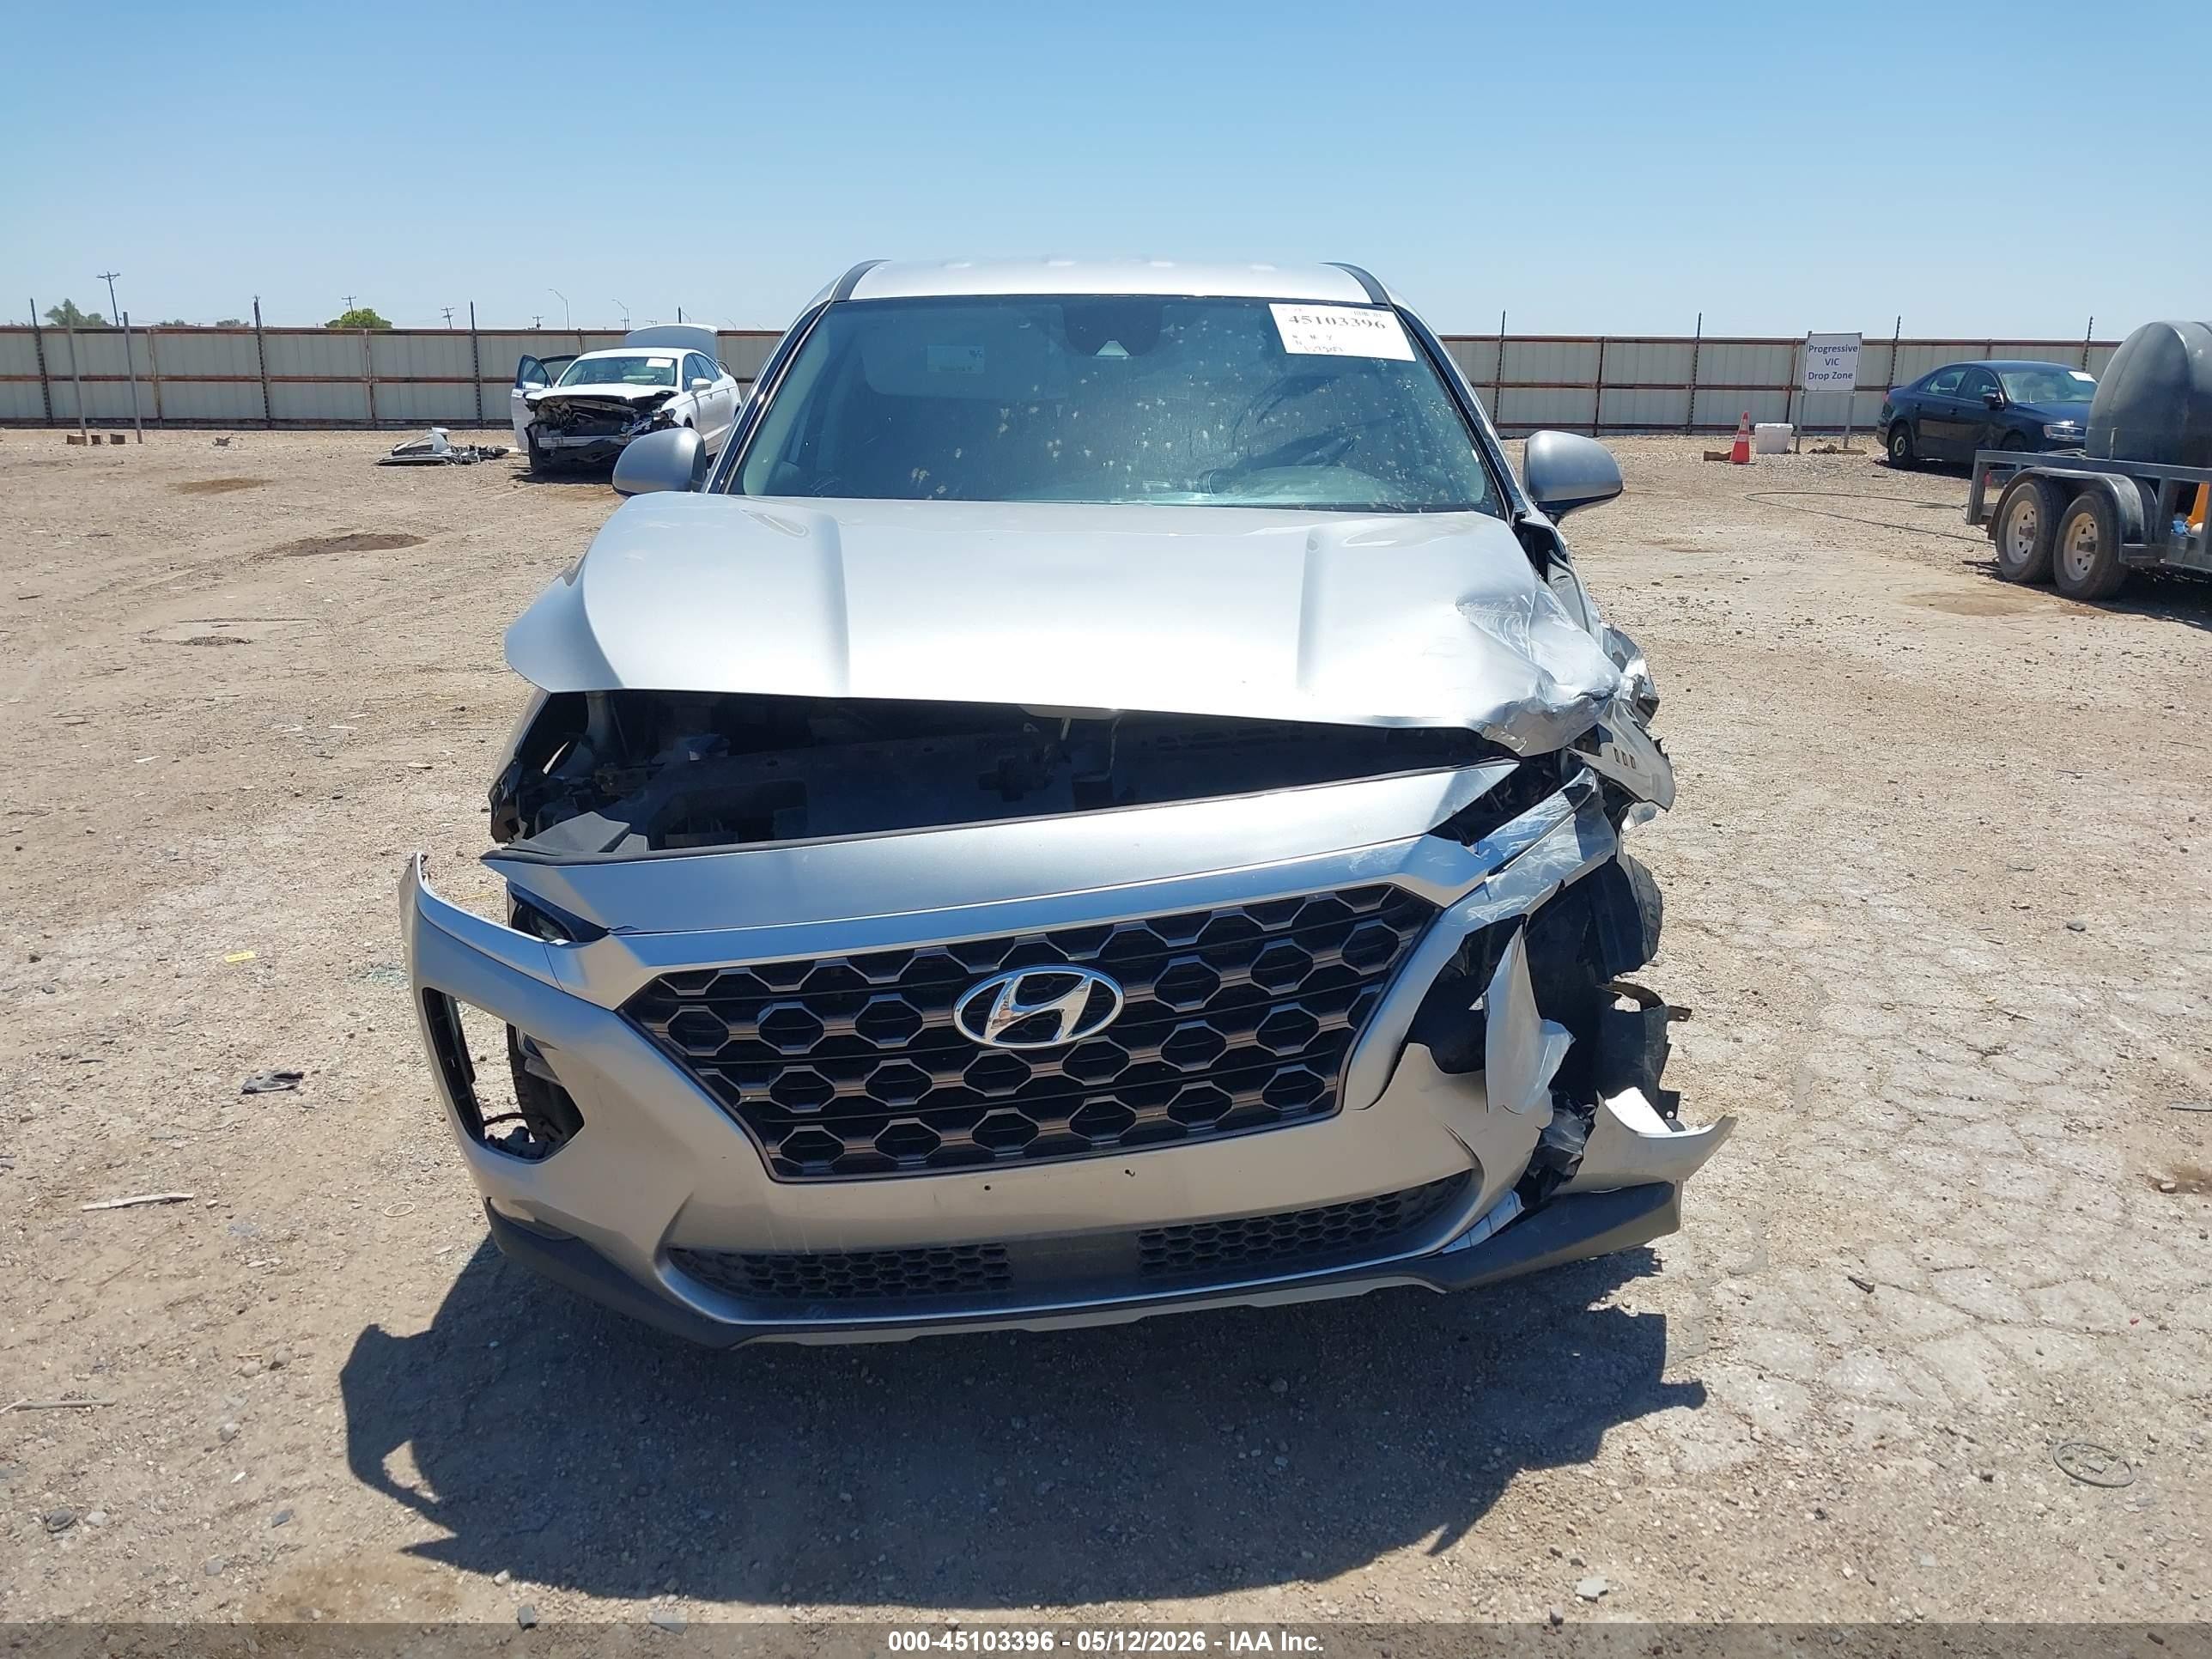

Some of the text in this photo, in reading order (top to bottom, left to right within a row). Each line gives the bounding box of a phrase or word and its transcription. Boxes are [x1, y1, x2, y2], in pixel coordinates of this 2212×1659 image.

[1289, 315, 1386, 330] 45103396
[1808, 344, 1858, 355] Progressive
[1808, 372, 1830, 381] Drop
